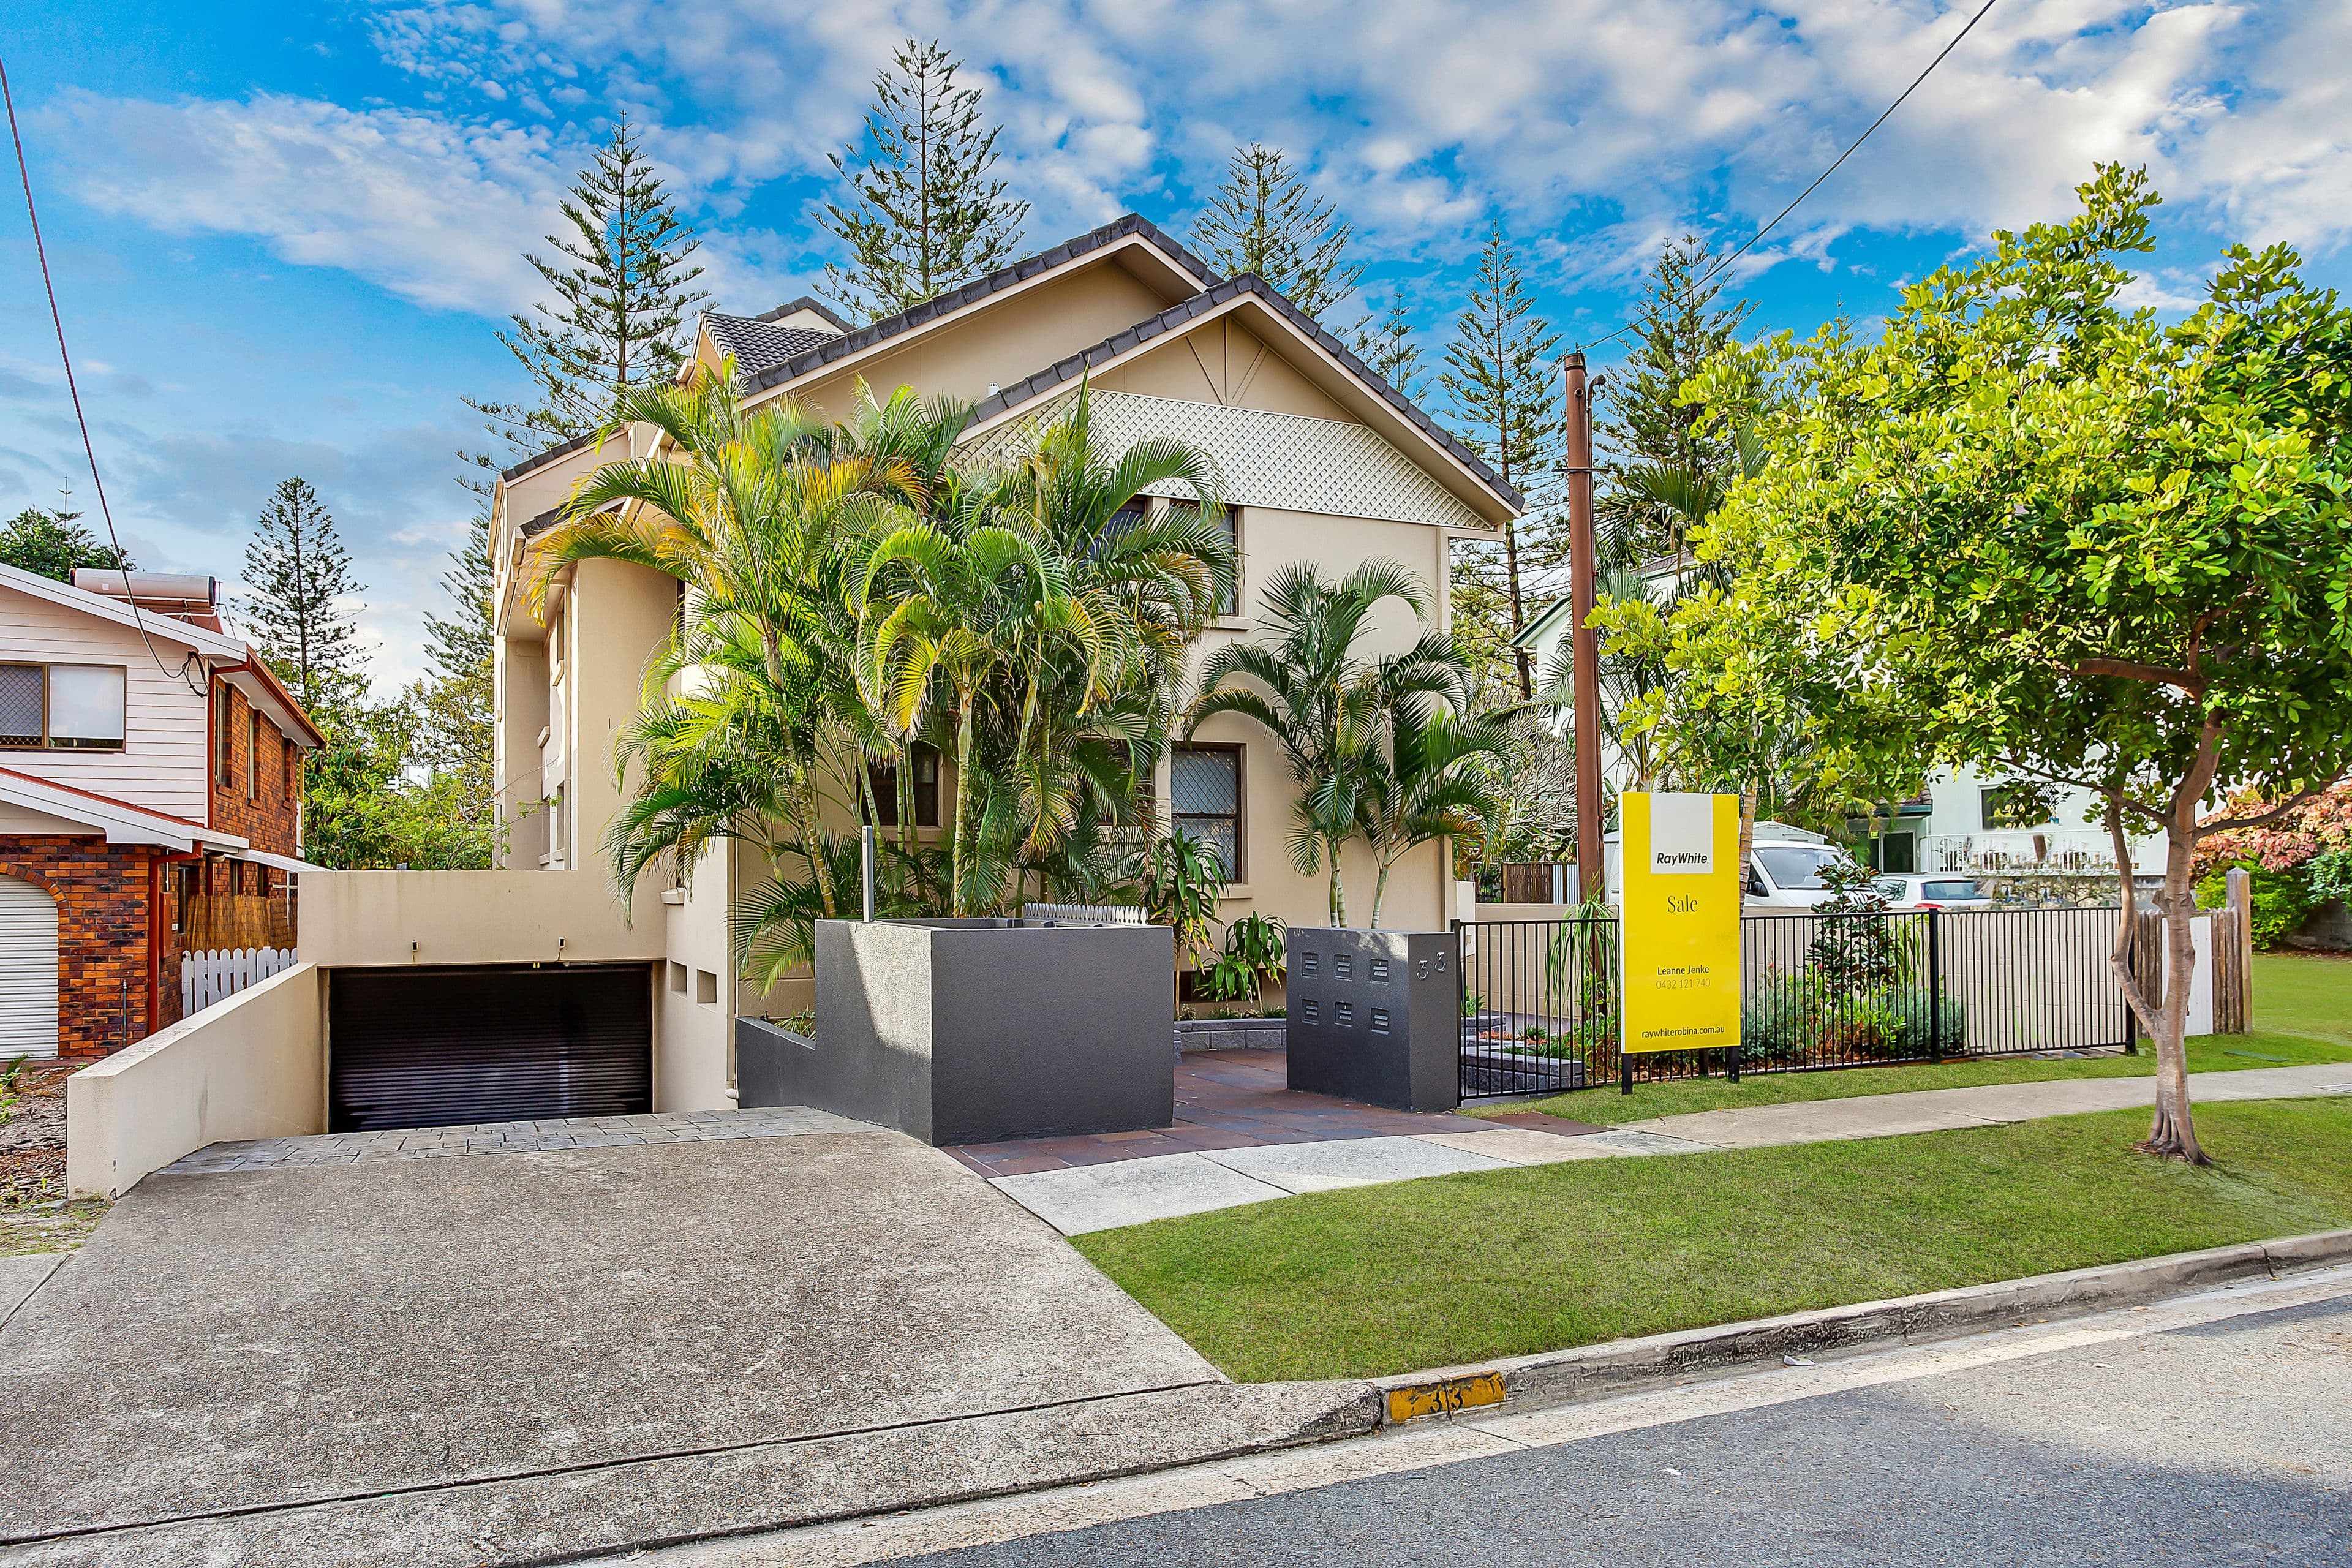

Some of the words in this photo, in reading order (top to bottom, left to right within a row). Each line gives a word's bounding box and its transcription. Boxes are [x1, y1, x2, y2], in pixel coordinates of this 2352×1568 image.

[1667, 894, 1698, 913] Sale
[1657, 967, 1685, 976] Leanne
[1687, 965, 1709, 974] Jenke
[1656, 979, 1676, 990] 0432
[1679, 979, 1694, 989] 121
[1696, 978, 1711, 987] 740
[1642, 1026, 1725, 1039] raywhiterobina.com.au
[1428, 1388, 1463, 1413] 33
